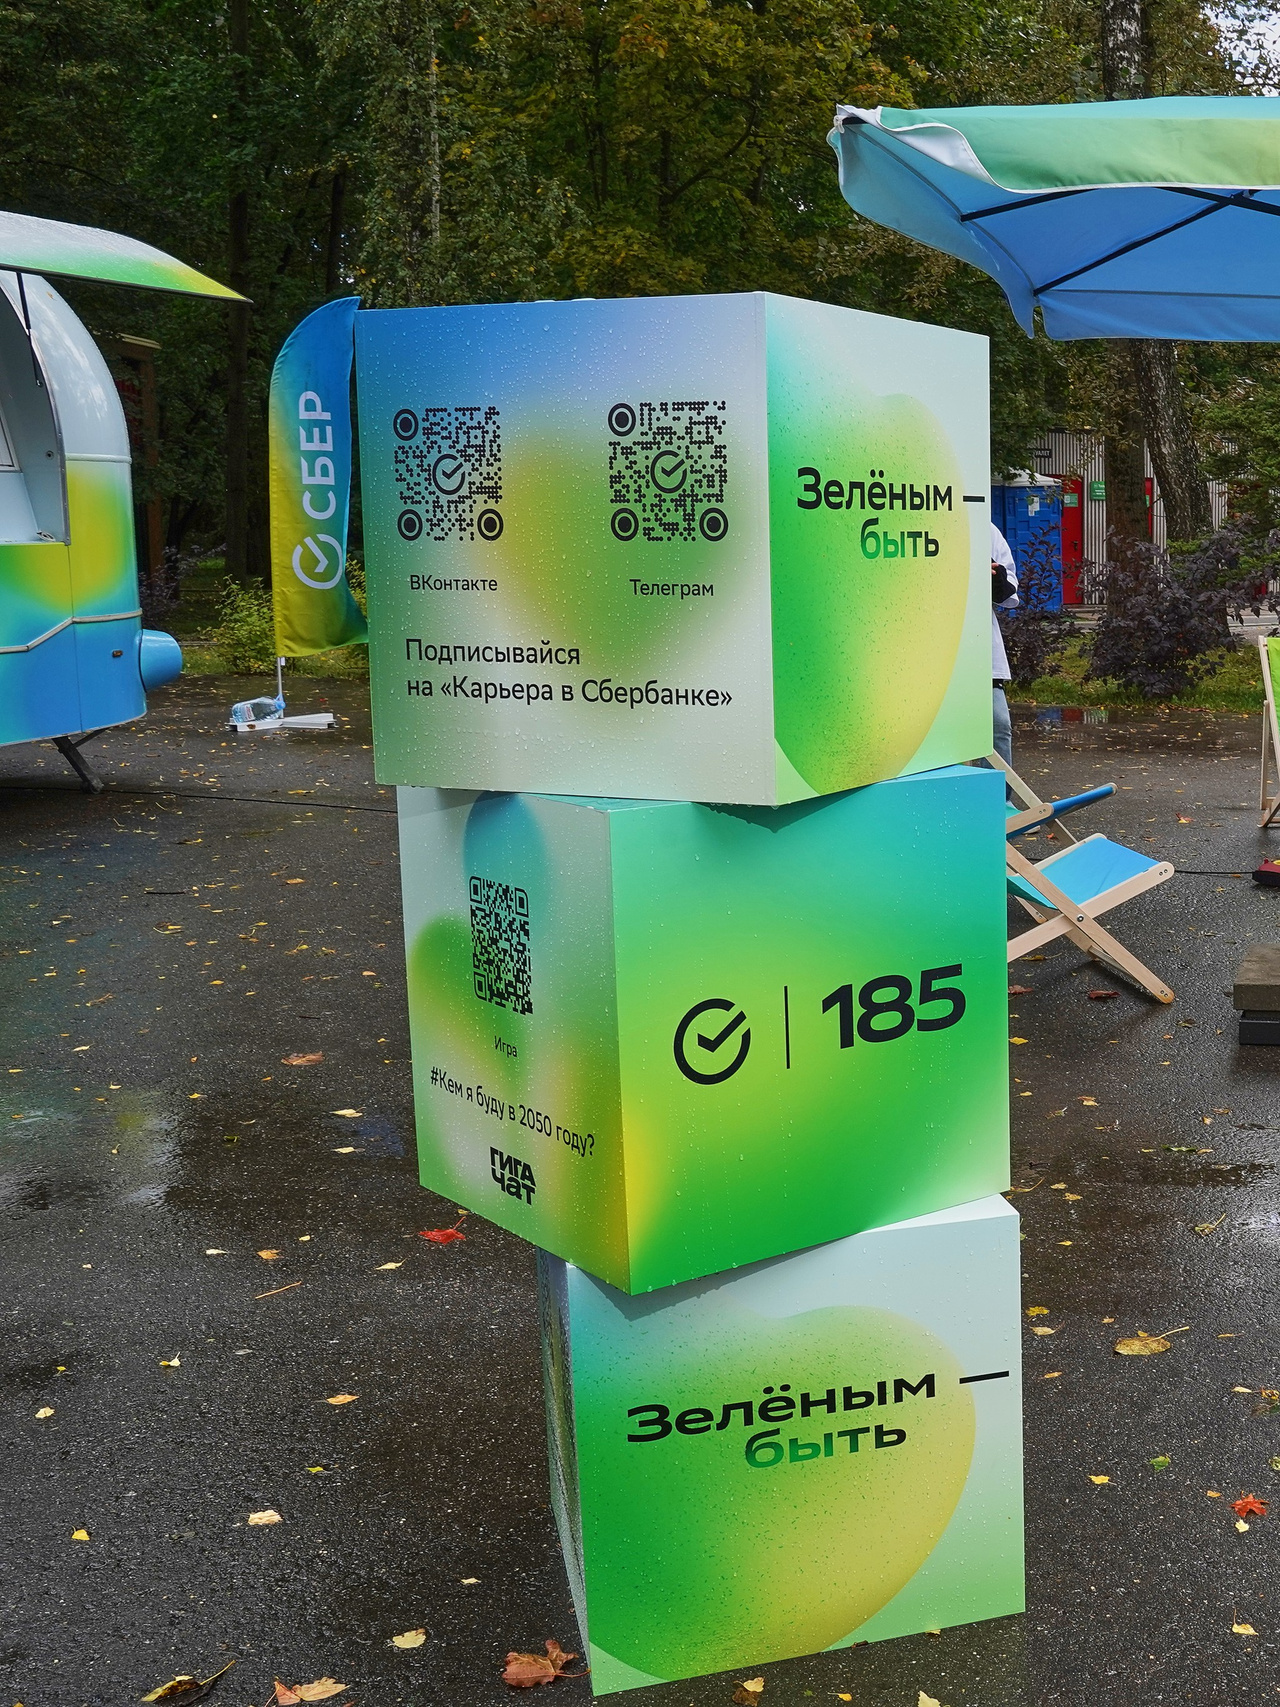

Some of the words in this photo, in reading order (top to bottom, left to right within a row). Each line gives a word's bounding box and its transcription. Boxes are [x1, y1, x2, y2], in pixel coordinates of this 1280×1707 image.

[299, 390, 336, 520] СБЕР
[797, 466, 953, 512] Зелёным
[860, 517, 940, 560] быть
[409, 574, 498, 592] ВКонтакте
[629, 578, 715, 600] Телеграм
[405, 638, 581, 666] Подписывайся
[407, 679, 434, 697] на
[440, 675, 553, 705] «Карьера
[561, 683, 574, 701] в
[581, 678, 733, 709] Сбербанке»
[822, 963, 967, 1050] 185
[494, 1035, 518, 1059] Игра
[430, 1066, 463, 1098] #Кем
[466, 1087, 473, 1103] я
[476, 1085, 505, 1121] буду
[508, 1105, 516, 1121] в
[519, 1104, 552, 1137] 2050
[556, 1125, 595, 1158] году?
[489, 1146, 537, 1188] ГИГА
[627, 1373, 936, 1444] Зелёным
[745, 1423, 907, 1469] быть
